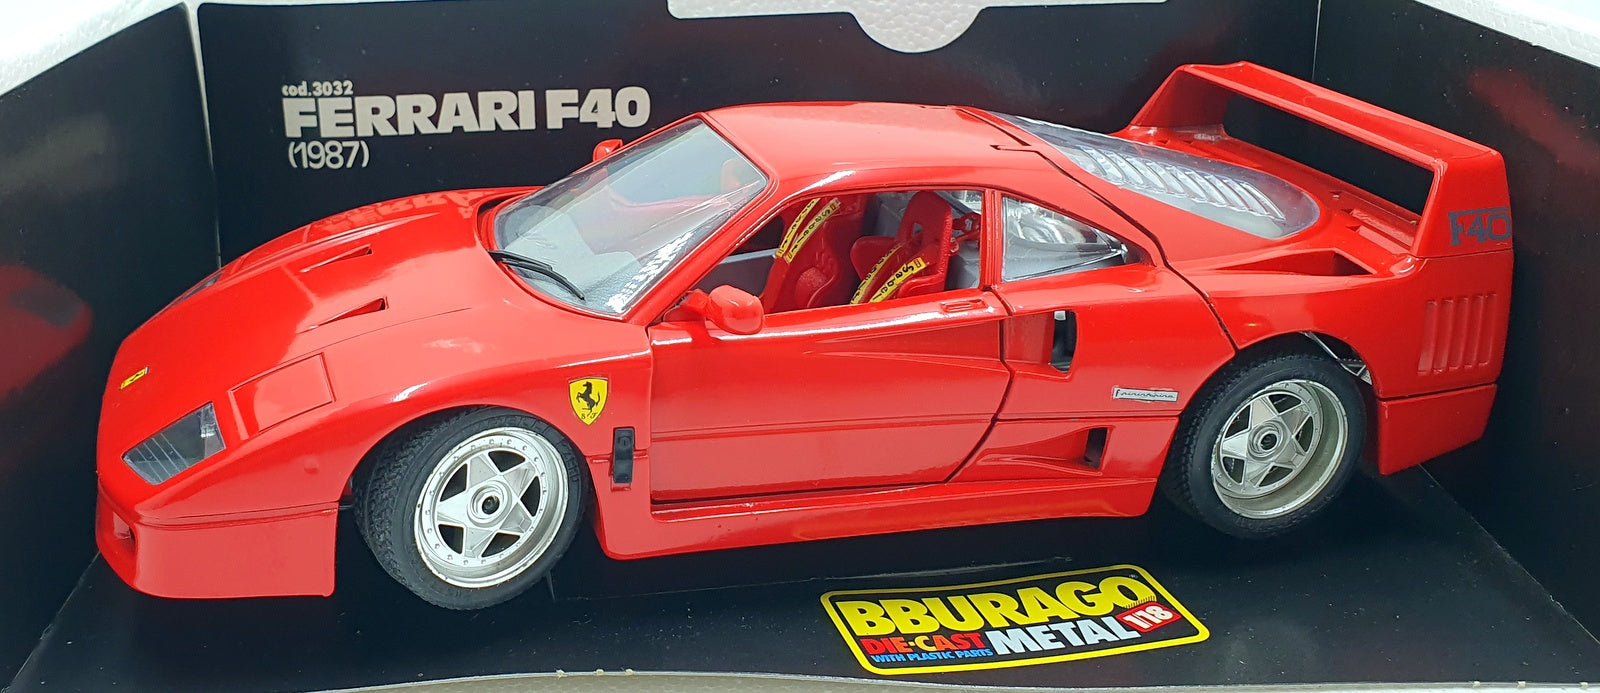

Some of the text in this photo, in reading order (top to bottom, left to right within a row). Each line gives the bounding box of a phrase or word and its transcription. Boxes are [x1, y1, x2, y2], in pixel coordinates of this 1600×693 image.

[282, 80, 354, 97] cod.3032
[282, 86, 651, 138] FERRARI F40
[288, 140, 370, 170] (1987)
[1447, 206, 1511, 247] F40
[872, 262, 915, 301] Sabel
[835, 575, 1158, 637] BBURAGO
[984, 616, 1142, 656] METAL
[1122, 605, 1174, 630] 1/18
[870, 648, 994, 663] WITH PLASTIC PARTS
